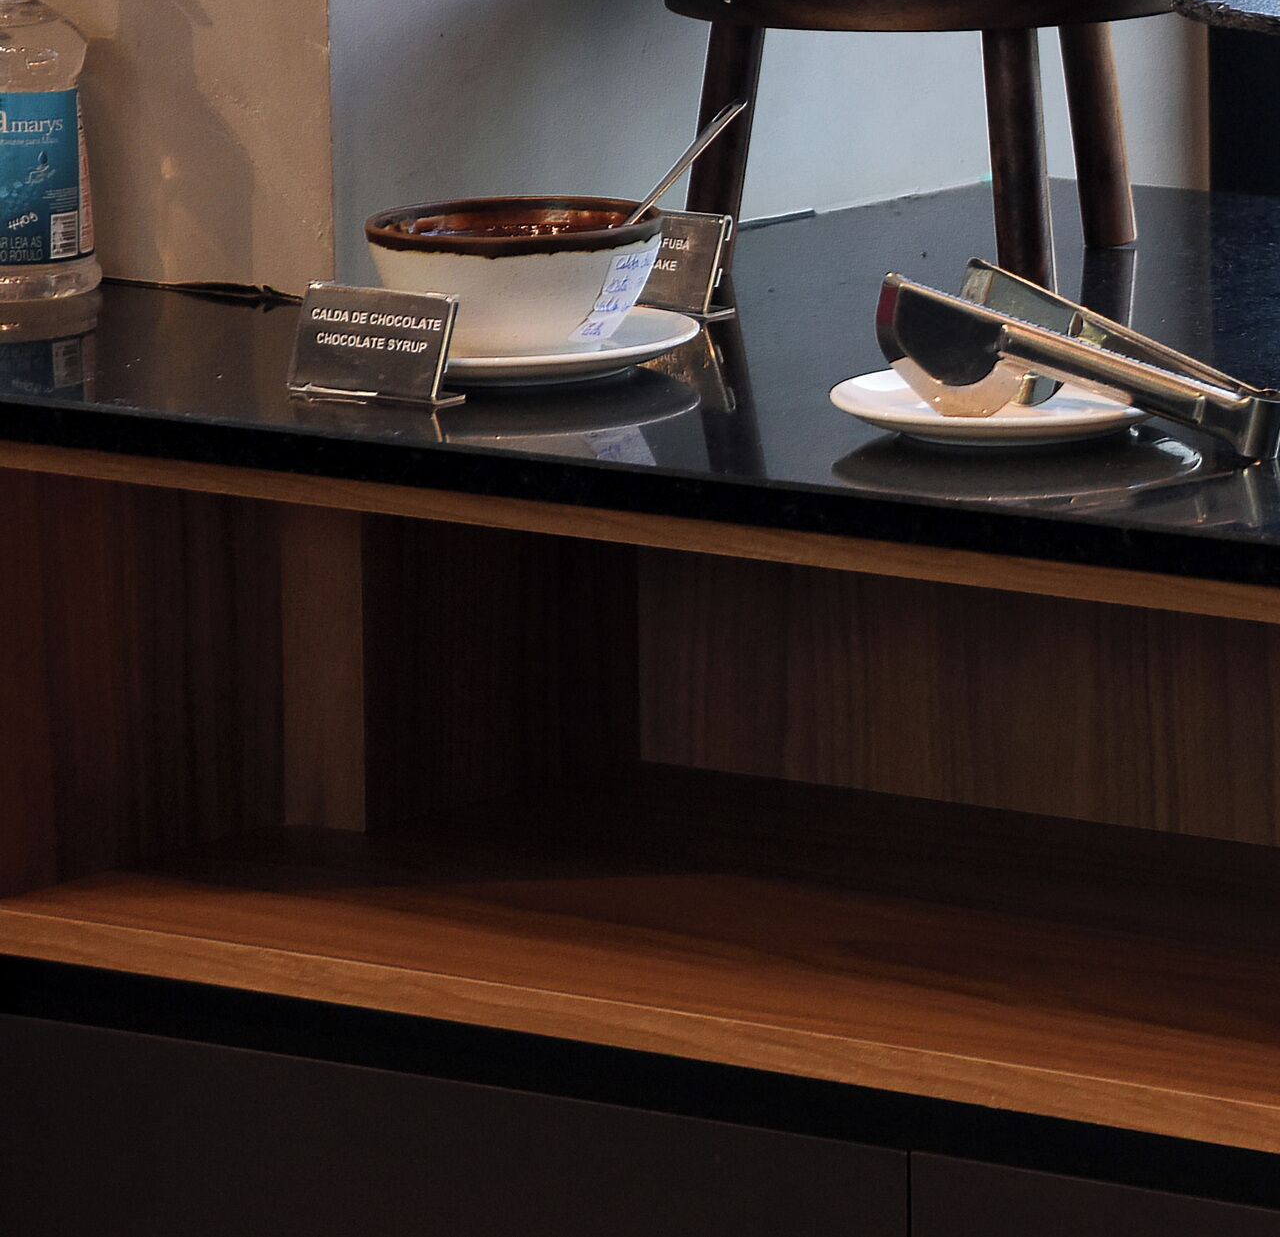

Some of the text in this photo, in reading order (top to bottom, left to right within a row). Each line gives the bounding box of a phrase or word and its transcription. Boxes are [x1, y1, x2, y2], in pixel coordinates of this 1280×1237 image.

[653, 259, 677, 271] AKE
[311, 308, 442, 331] CALDA DE CHOCOLATE
[316, 332, 428, 353] CHOCOLATE SYRUP
